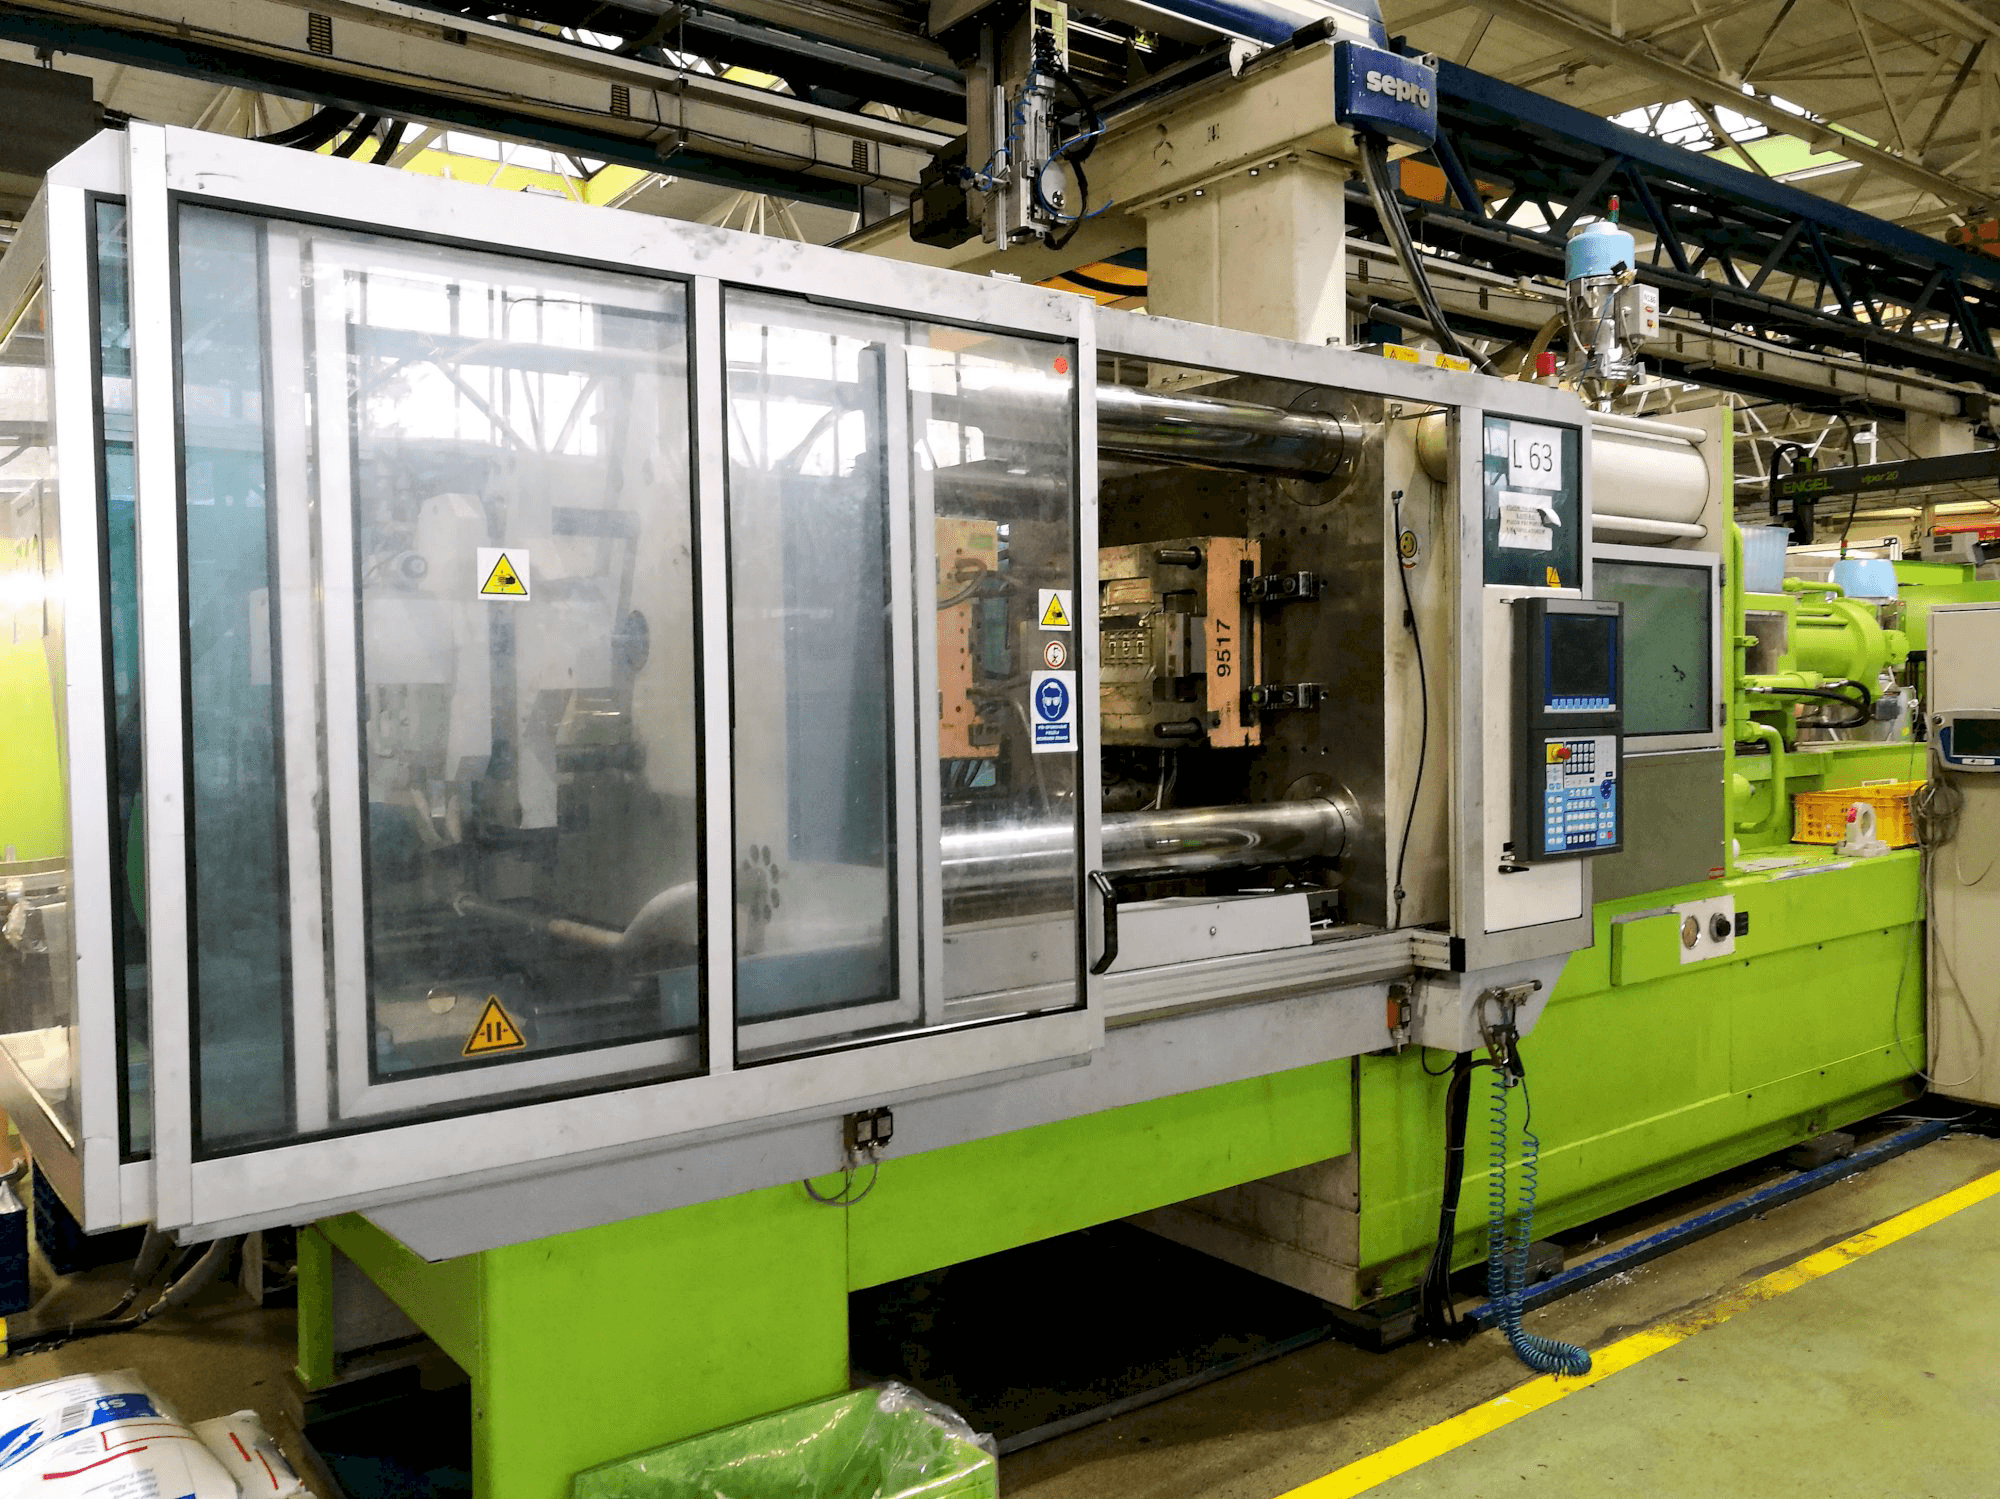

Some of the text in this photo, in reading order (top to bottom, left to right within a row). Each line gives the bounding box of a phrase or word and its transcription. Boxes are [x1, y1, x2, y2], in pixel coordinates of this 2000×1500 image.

[1366, 70, 1430, 109] sepro
[1513, 439, 1553, 472] L 63
[1782, 477, 1834, 495] ENGEL
[1216, 618, 1232, 678] 9517
